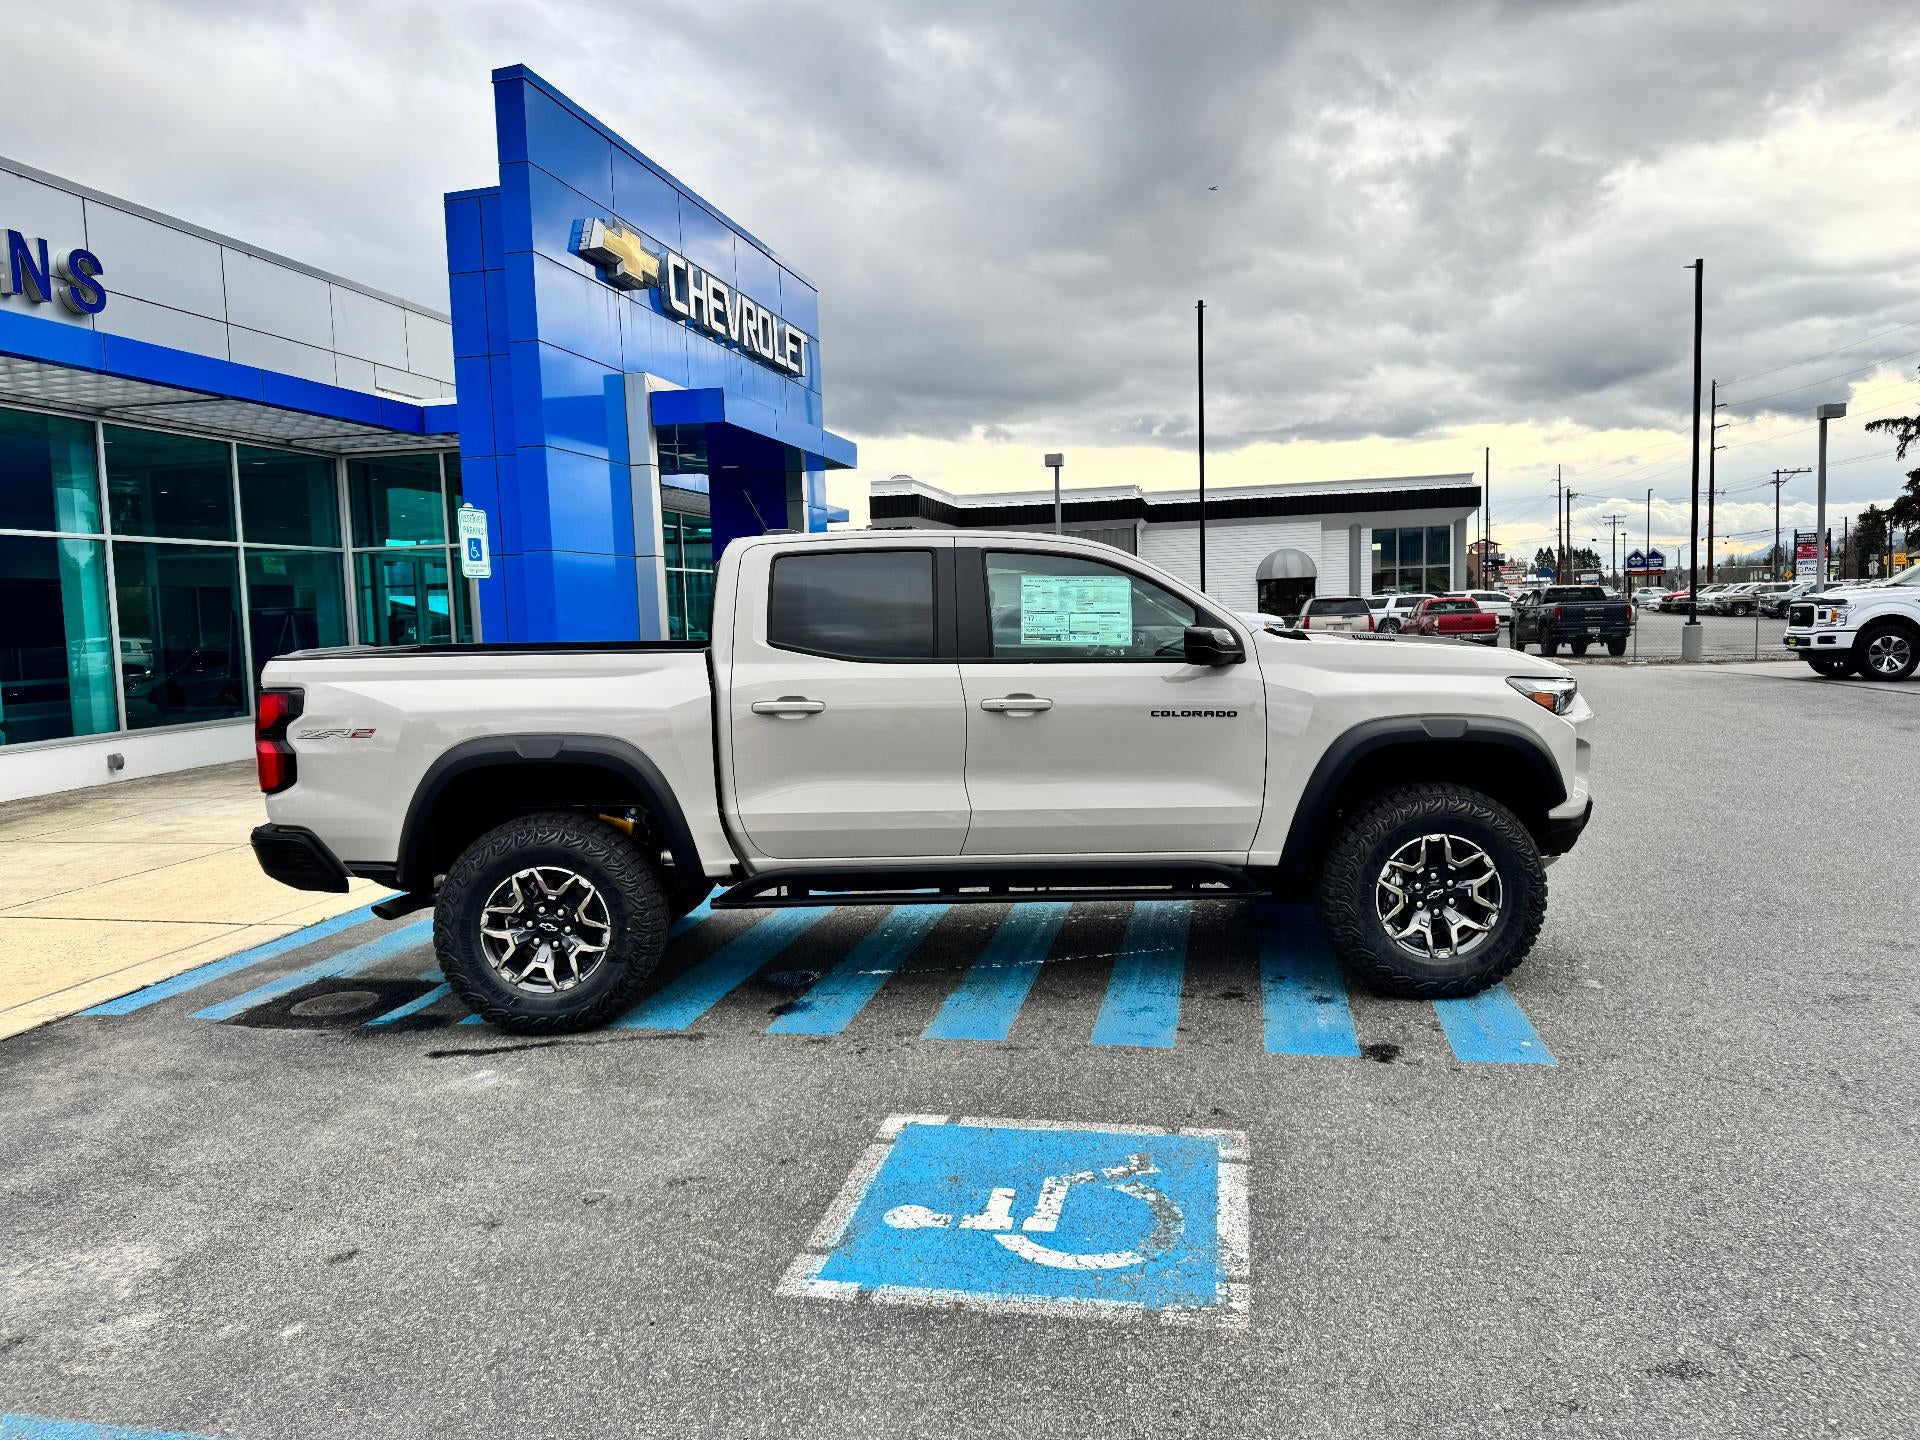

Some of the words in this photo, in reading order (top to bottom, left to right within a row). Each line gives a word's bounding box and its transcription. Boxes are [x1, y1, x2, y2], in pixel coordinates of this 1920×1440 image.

[666, 252, 808, 377] CHEVROLET
[461, 513, 485, 525] RESERVED
[463, 525, 485, 536] PARKING
[1351, 633, 1396, 642] TURBOMAX
[1150, 709, 1238, 718] COLORADO
[296, 728, 377, 739] ZR2
